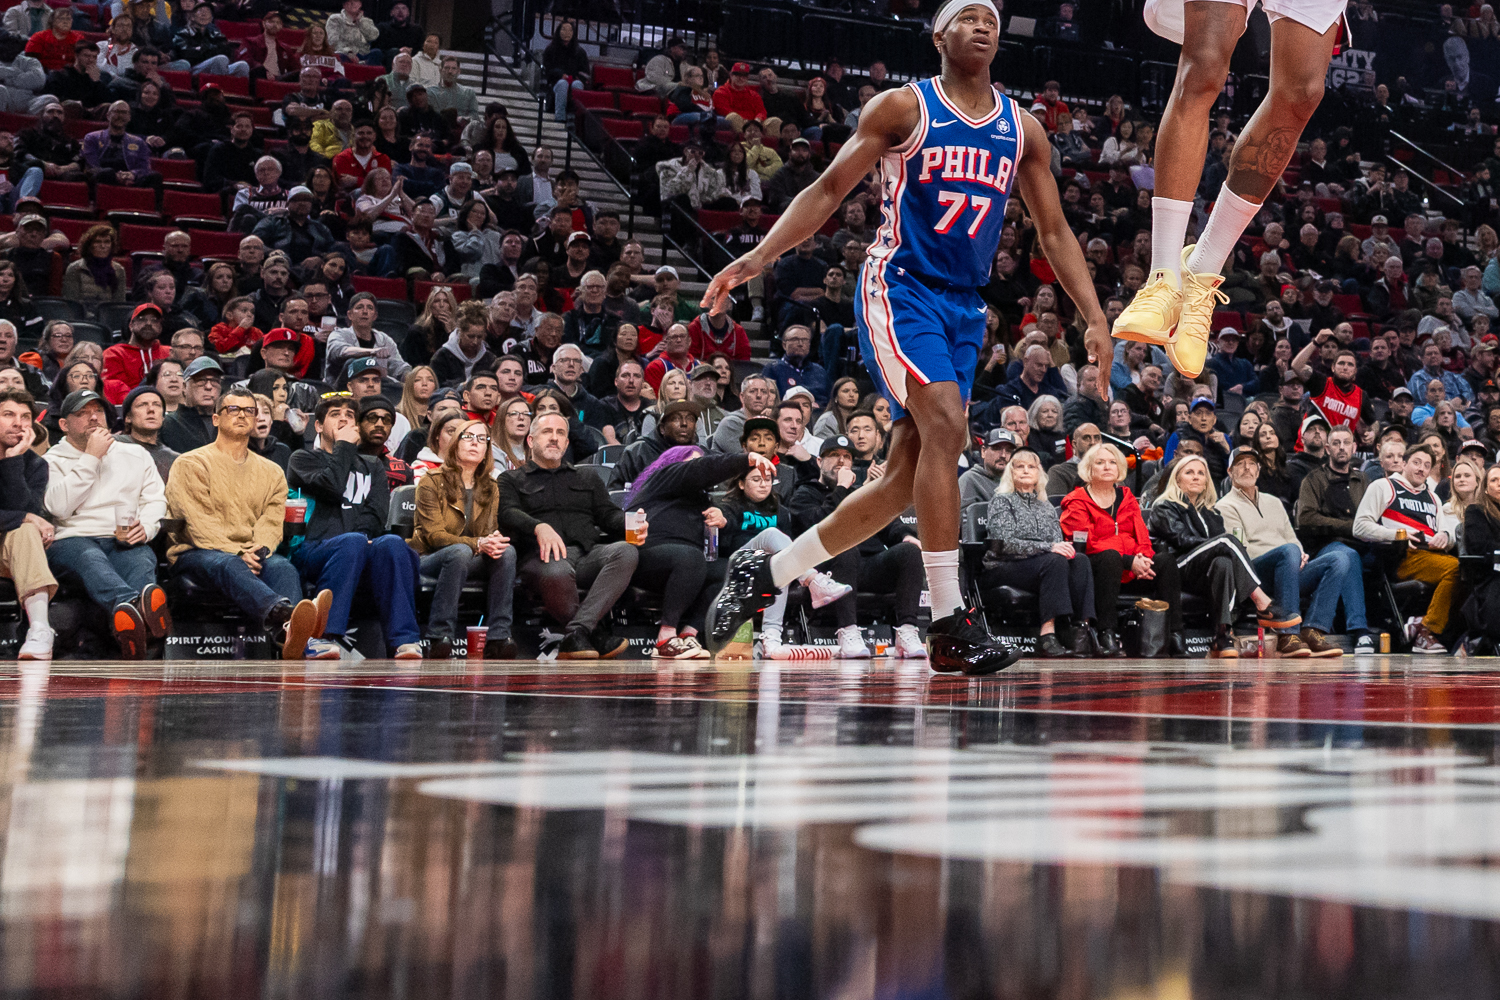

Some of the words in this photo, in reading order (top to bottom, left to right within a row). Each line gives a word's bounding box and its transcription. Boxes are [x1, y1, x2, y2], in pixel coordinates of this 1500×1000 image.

[919, 145, 1013, 195] PHILA
[934, 190, 992, 239] 77
[1323, 396, 1359, 419] PORTLAND
[1399, 498, 1437, 515] PORTLAND
[166, 636, 201, 645] SPIRIT
[203, 635, 266, 644] MOUNAIN
